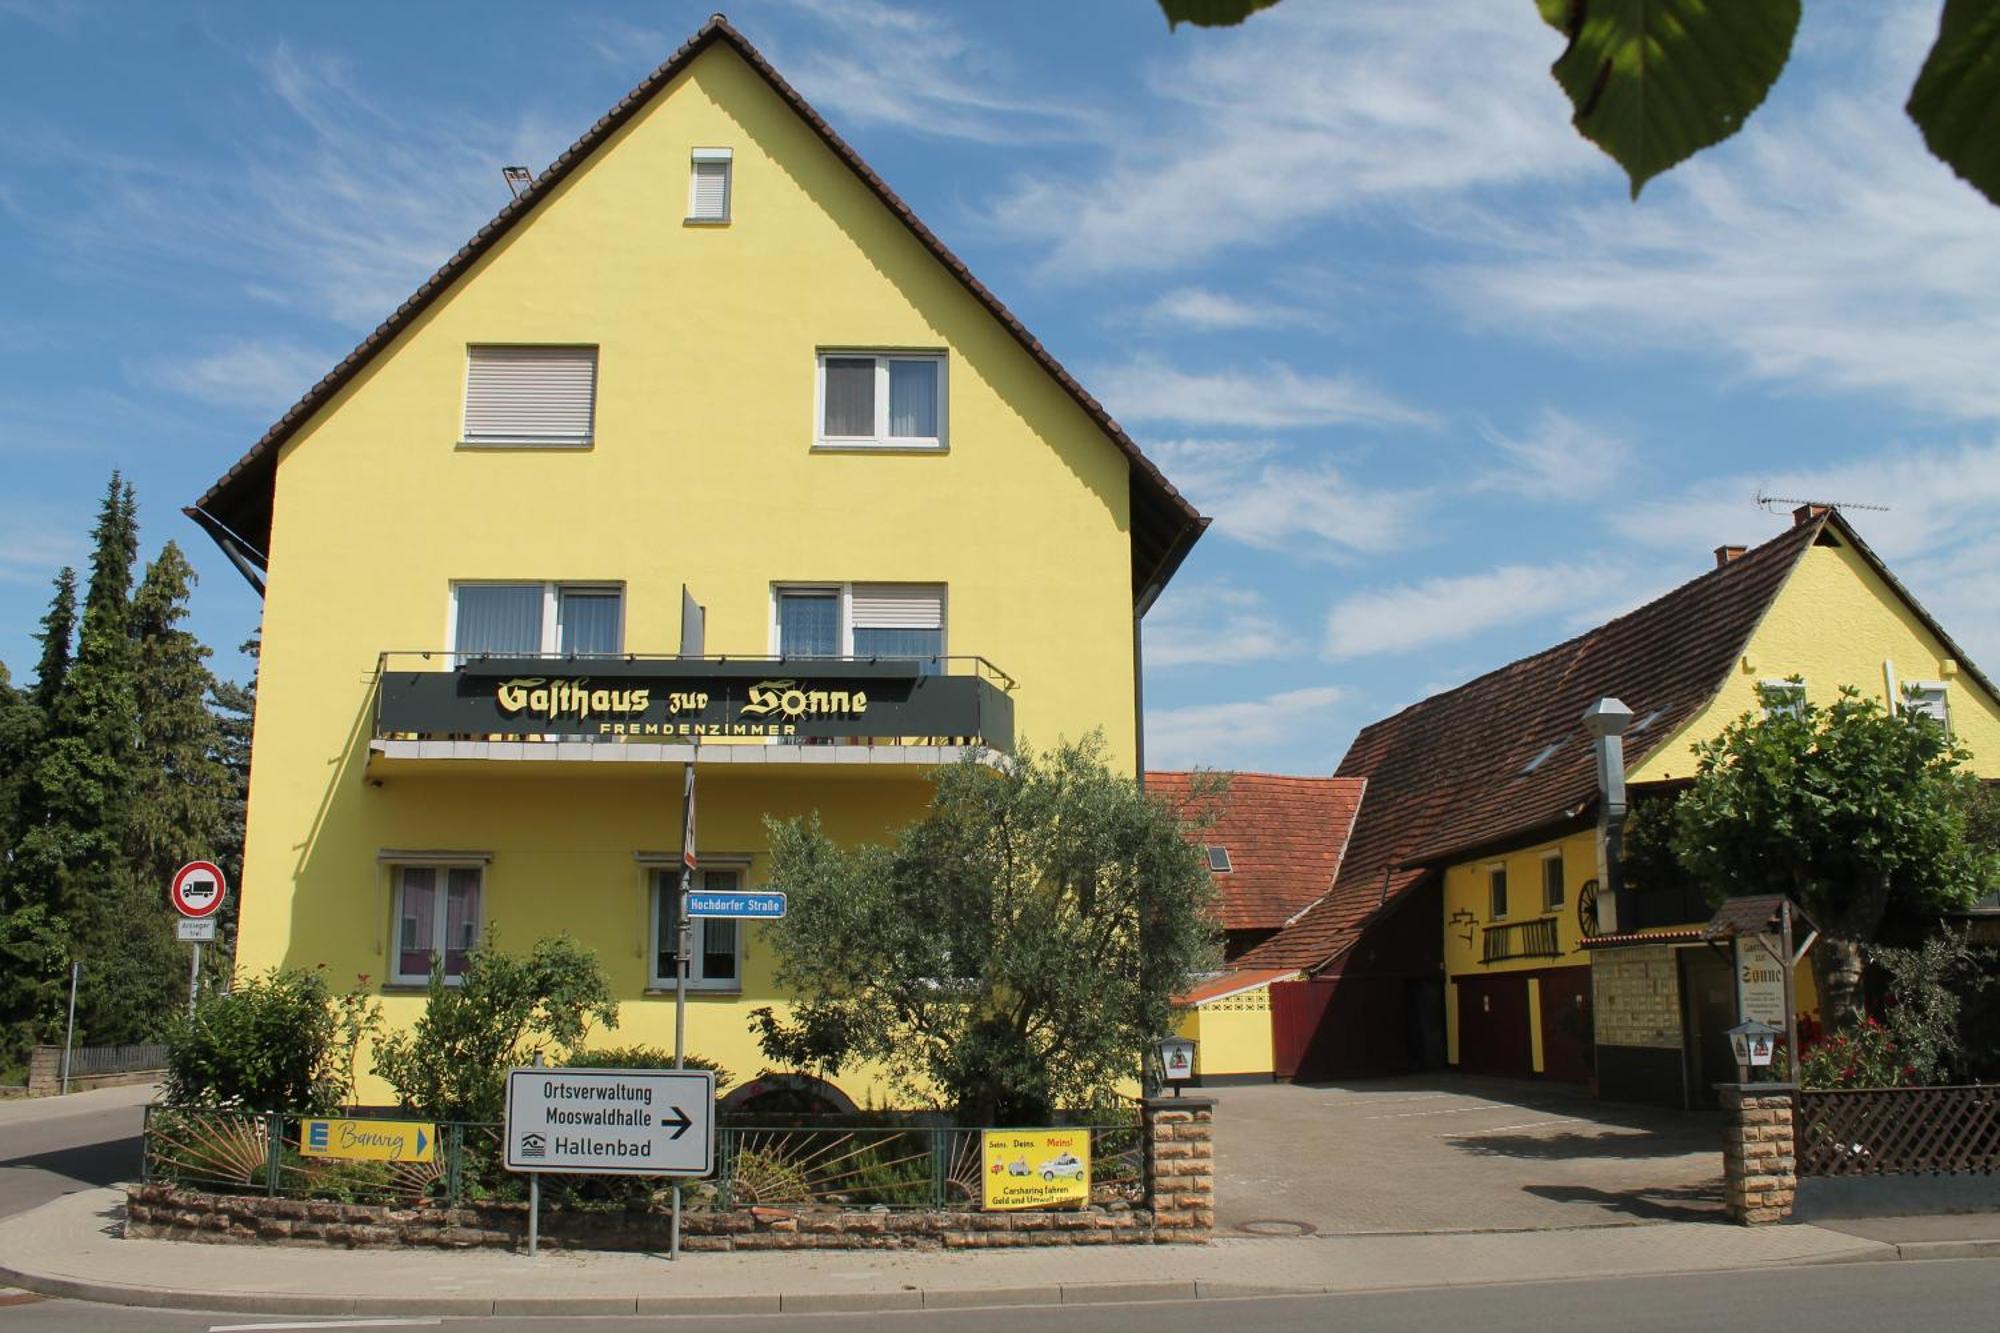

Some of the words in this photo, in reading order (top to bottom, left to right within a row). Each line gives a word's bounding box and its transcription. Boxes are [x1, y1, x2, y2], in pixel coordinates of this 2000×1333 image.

[669, 691, 709, 714] zur
[740, 680, 868, 718] Sonne
[600, 723, 796, 735] FREMDENZIMMER
[691, 898, 745, 911] Hochdorfer
[748, 899, 780, 911] Straße
[1742, 966, 1782, 983] Sonne
[543, 1081, 652, 1105] Ortsverwaltung
[546, 1107, 652, 1127] Mooswaldhalle
[555, 1137, 652, 1157] Hallenbad
[1003, 1186, 1043, 1196] Carsharing
